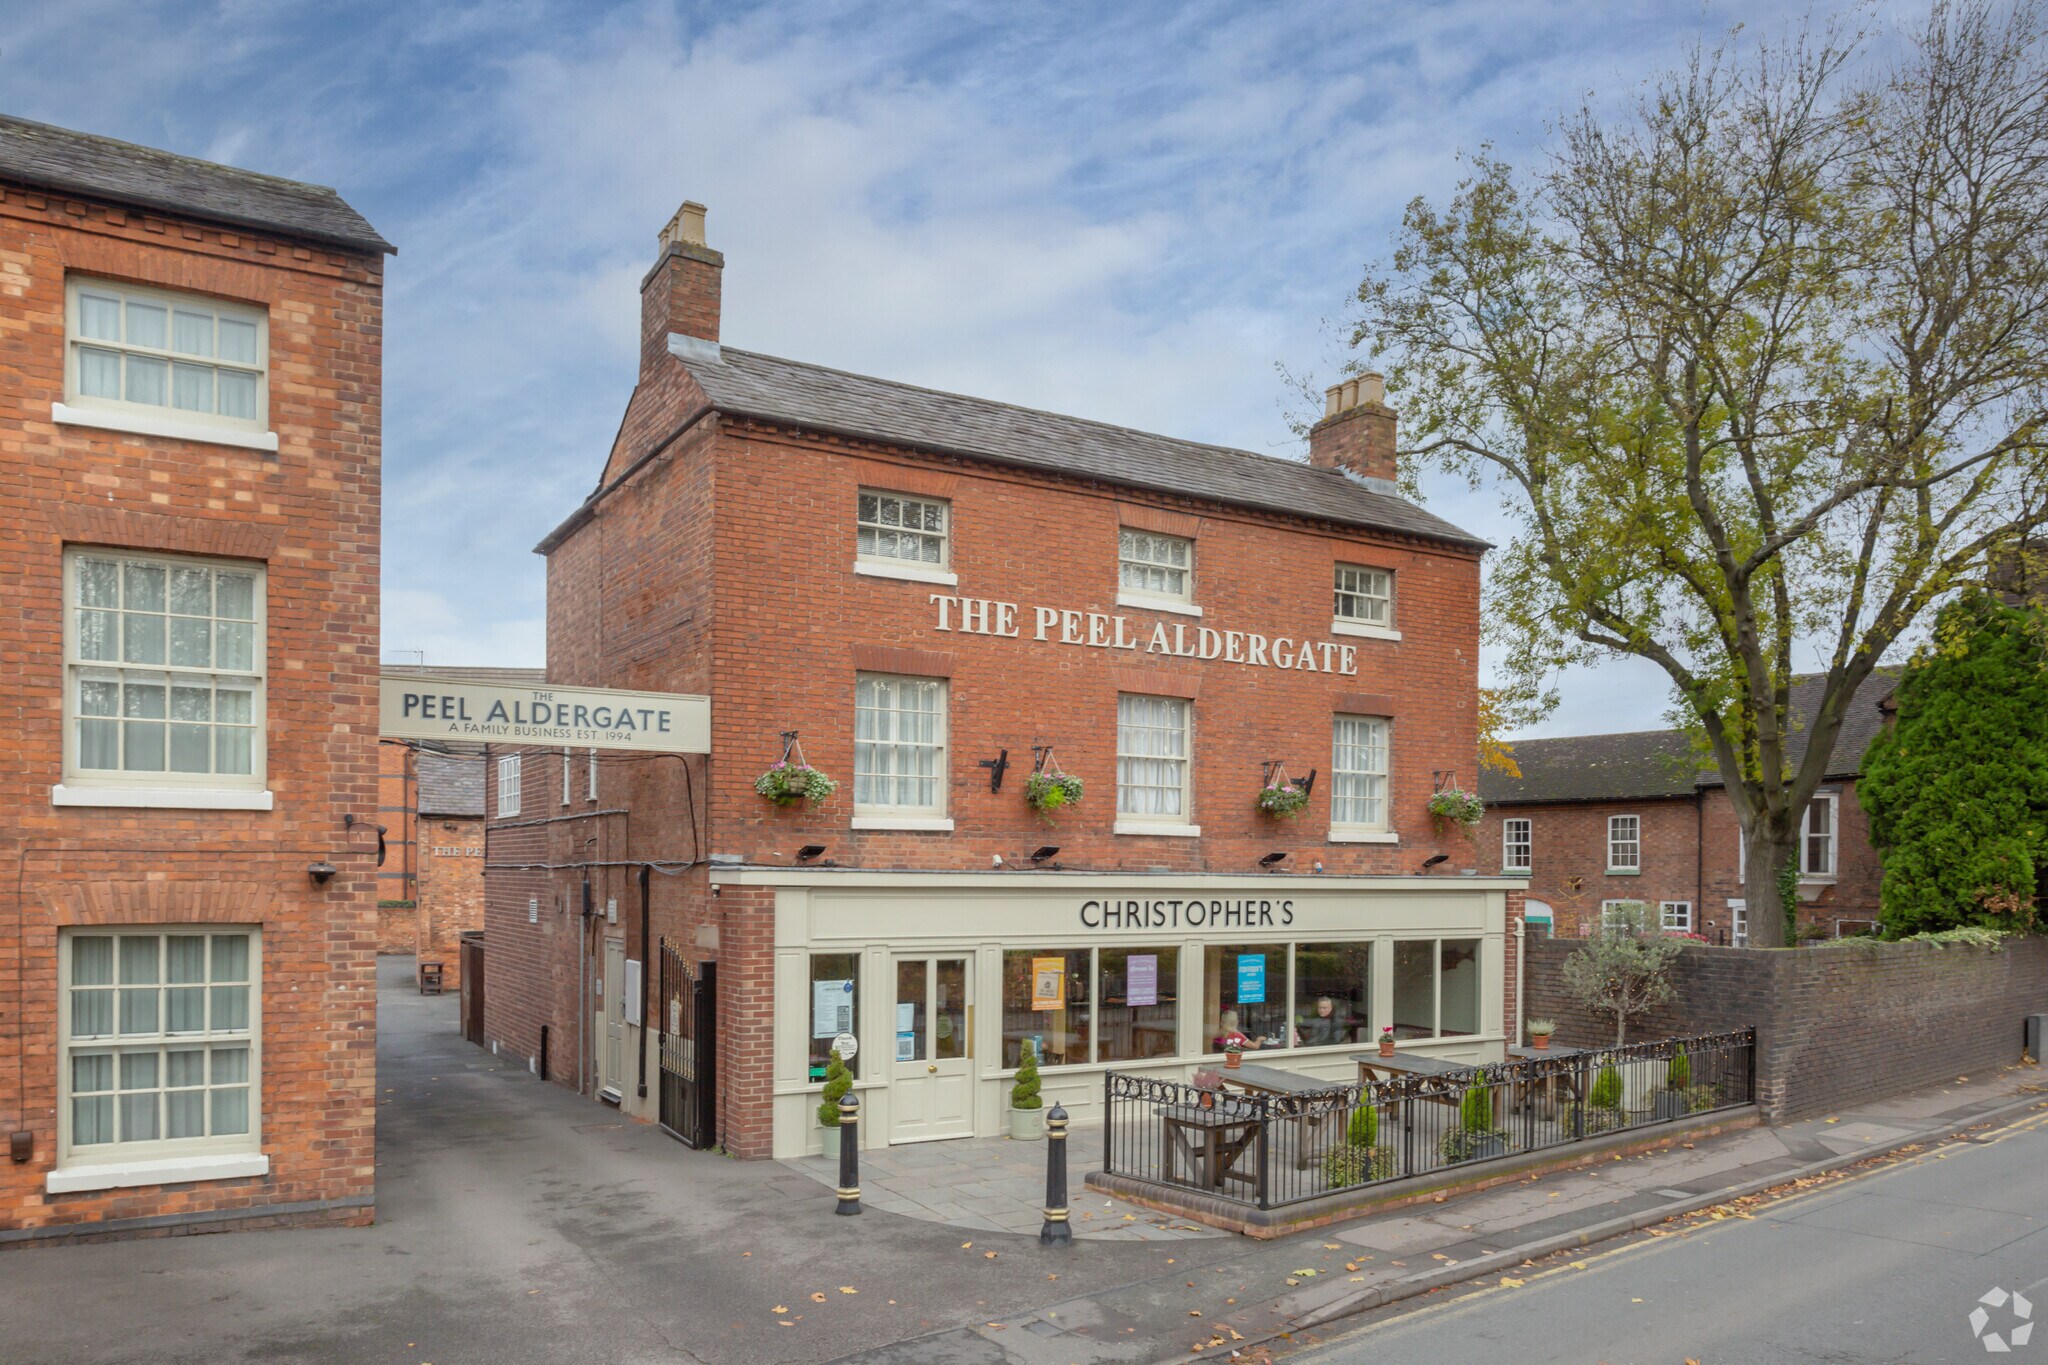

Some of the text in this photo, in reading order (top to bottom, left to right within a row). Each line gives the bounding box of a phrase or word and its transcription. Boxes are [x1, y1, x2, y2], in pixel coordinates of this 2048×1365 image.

[929, 593, 1358, 677] THE PEEL ALDERGATE
[532, 691, 554, 702] THE
[402, 692, 672, 733] PEEL ALDERGATE
[449, 722, 459, 732] A
[464, 723, 509, 735] FAMILY
[514, 726, 571, 739] BUSINESS
[605, 731, 632, 742] 1994
[432, 846, 462, 857] THE
[1080, 900, 1294, 929] CHRISTOPHER'S
